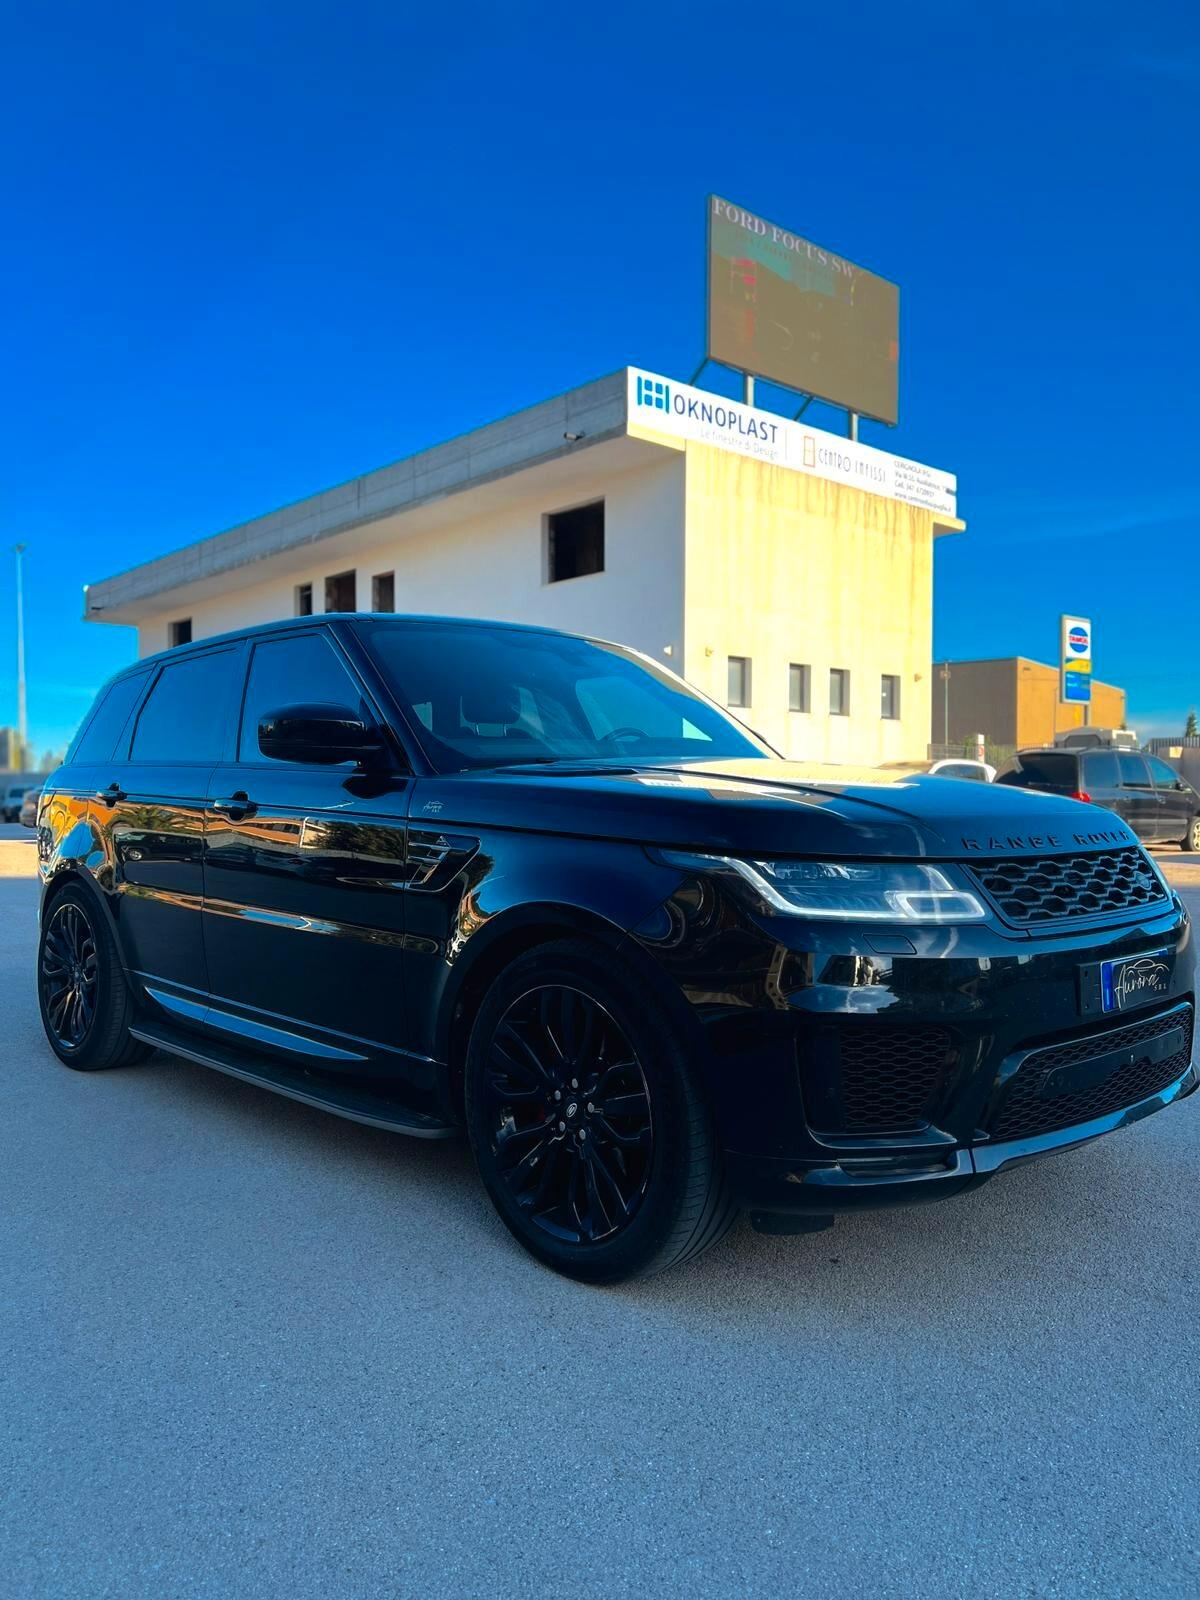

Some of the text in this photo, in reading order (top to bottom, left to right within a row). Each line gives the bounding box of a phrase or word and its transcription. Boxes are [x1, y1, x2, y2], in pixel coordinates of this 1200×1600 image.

[713, 198, 855, 278] FORD FOCUS SW
[673, 394, 779, 444] OKNOPLAST
[818, 448, 851, 472] CENTRO
[960, 830, 1130, 850] RANGE ROVER
